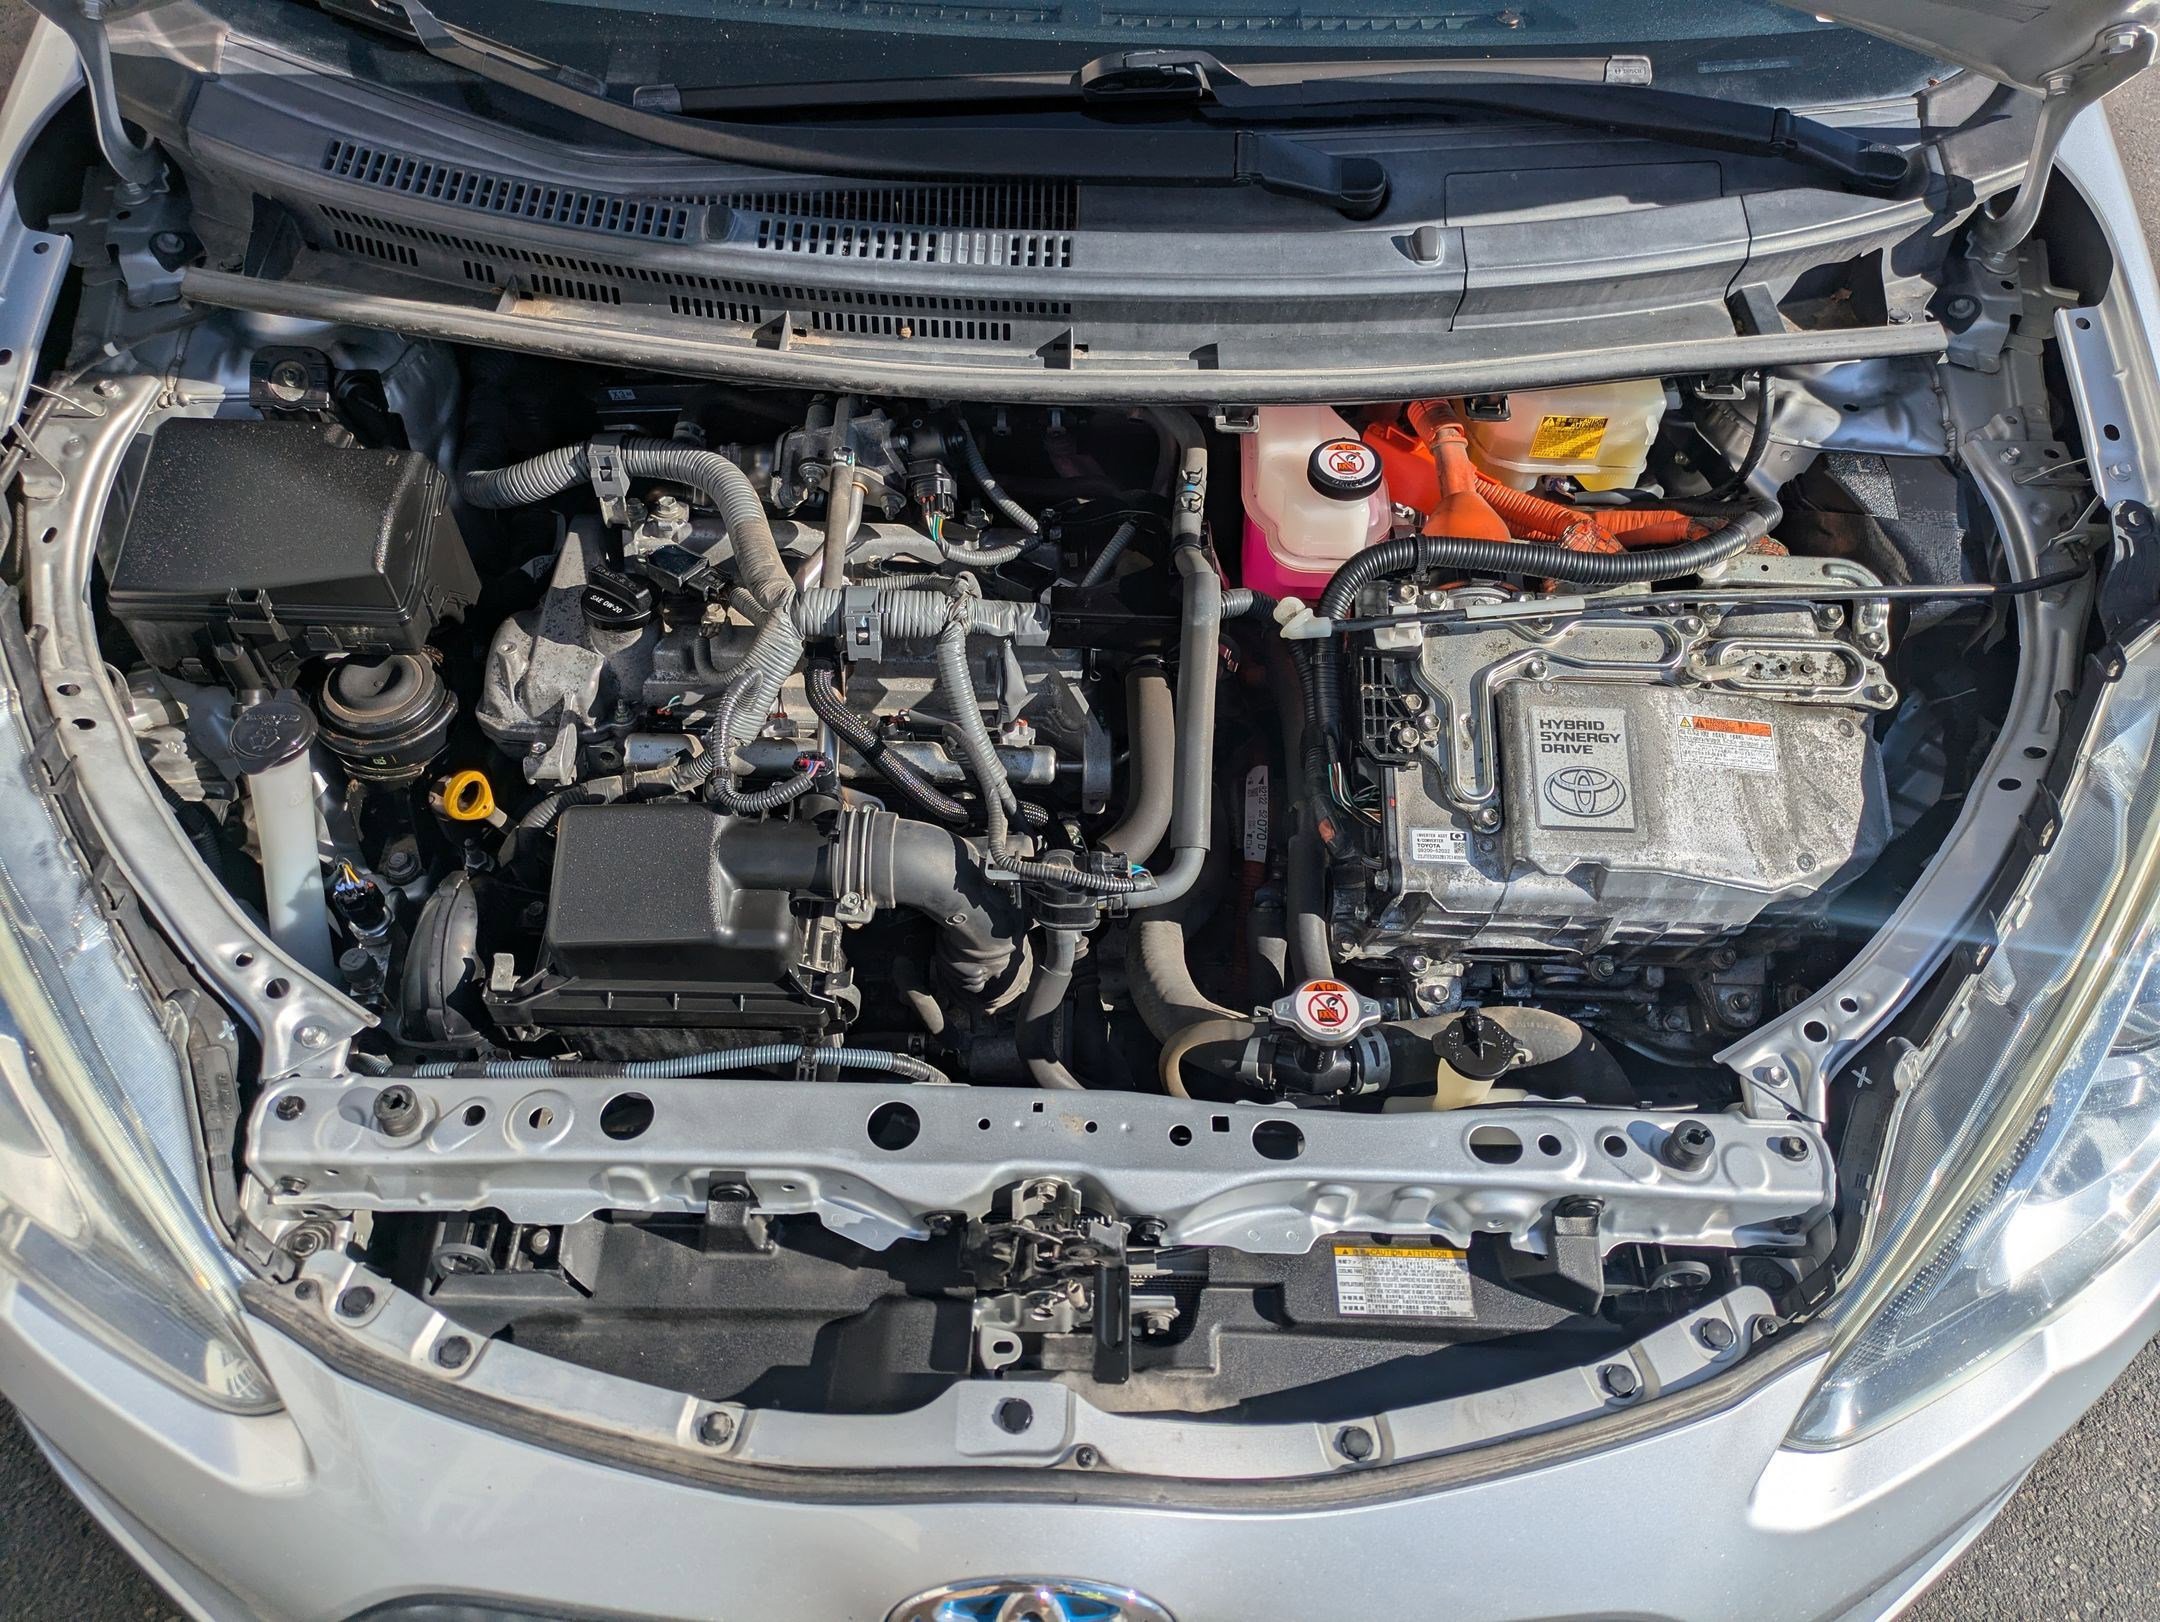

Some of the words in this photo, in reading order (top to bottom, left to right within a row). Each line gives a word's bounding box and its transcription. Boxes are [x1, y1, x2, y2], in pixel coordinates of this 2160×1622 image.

[590, 594, 604, 603] SAE
[602, 600, 623, 614] 0W-20
[1540, 719, 1605, 731] HYBRID
[1540, 731, 1621, 743] SYNERGY
[1541, 743, 1594, 755] DRIVE
[1370, 1248, 1403, 1257] CAUTION
[1407, 1249, 1447, 1258] ATTENTION
